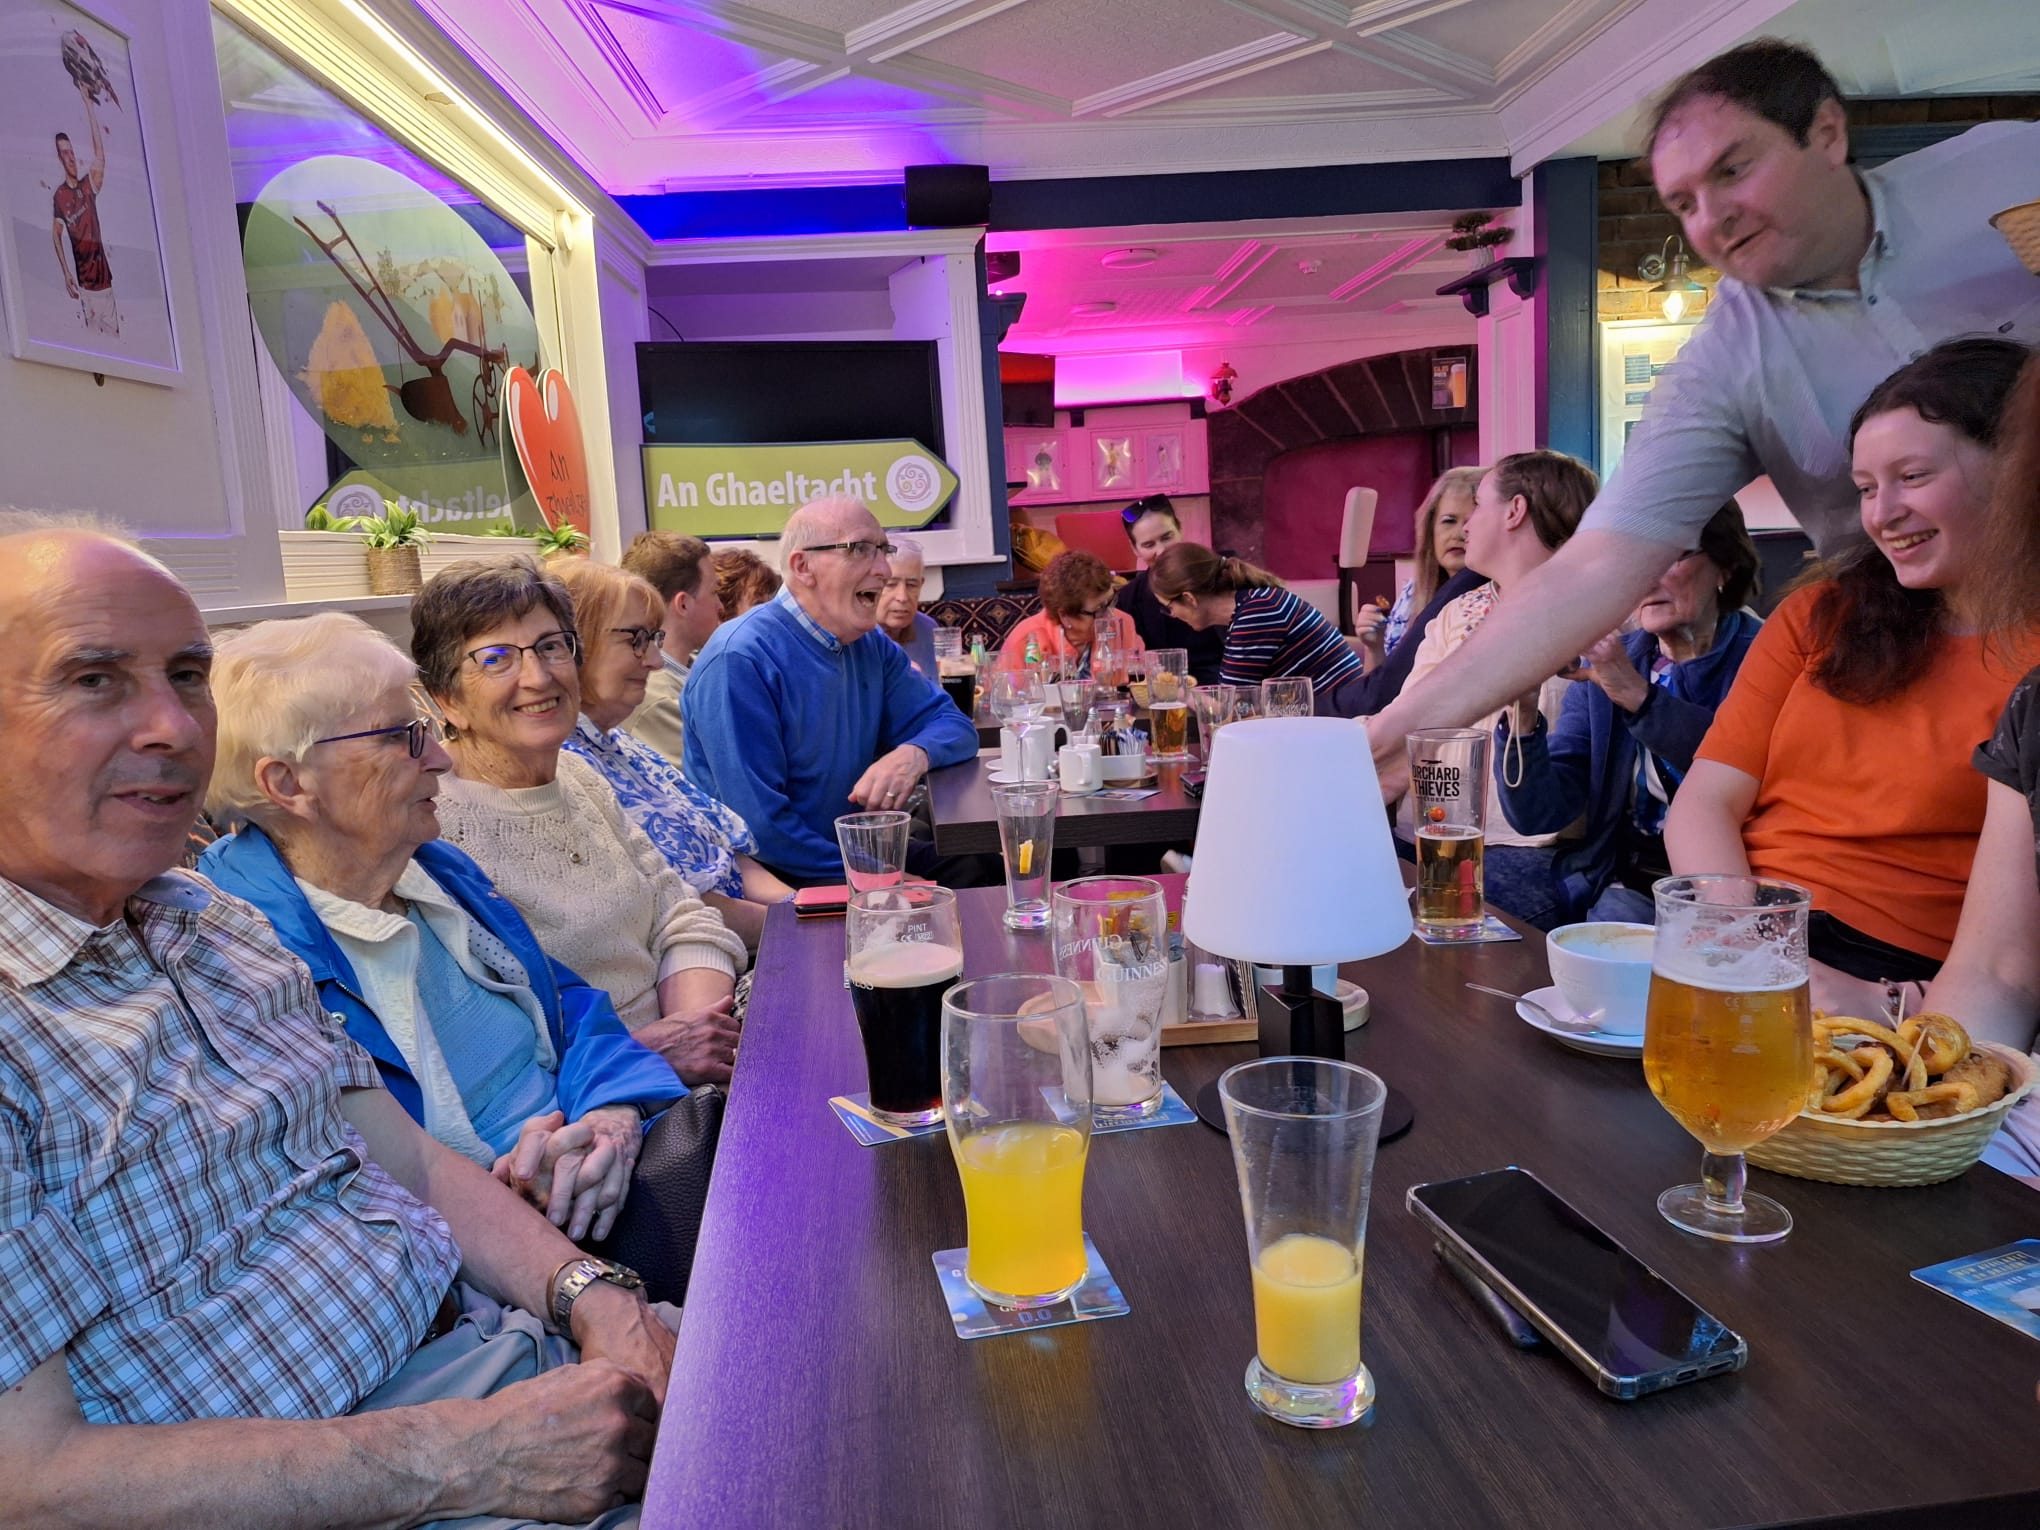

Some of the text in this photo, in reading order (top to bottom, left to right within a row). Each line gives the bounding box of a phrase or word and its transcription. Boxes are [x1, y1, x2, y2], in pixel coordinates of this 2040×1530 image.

[657, 468, 878, 508] An Ghaeltacht
[1412, 764, 1460, 781] ORCHARD
[1413, 779, 1460, 797] THIEVES
[907, 923, 928, 933] PINT
